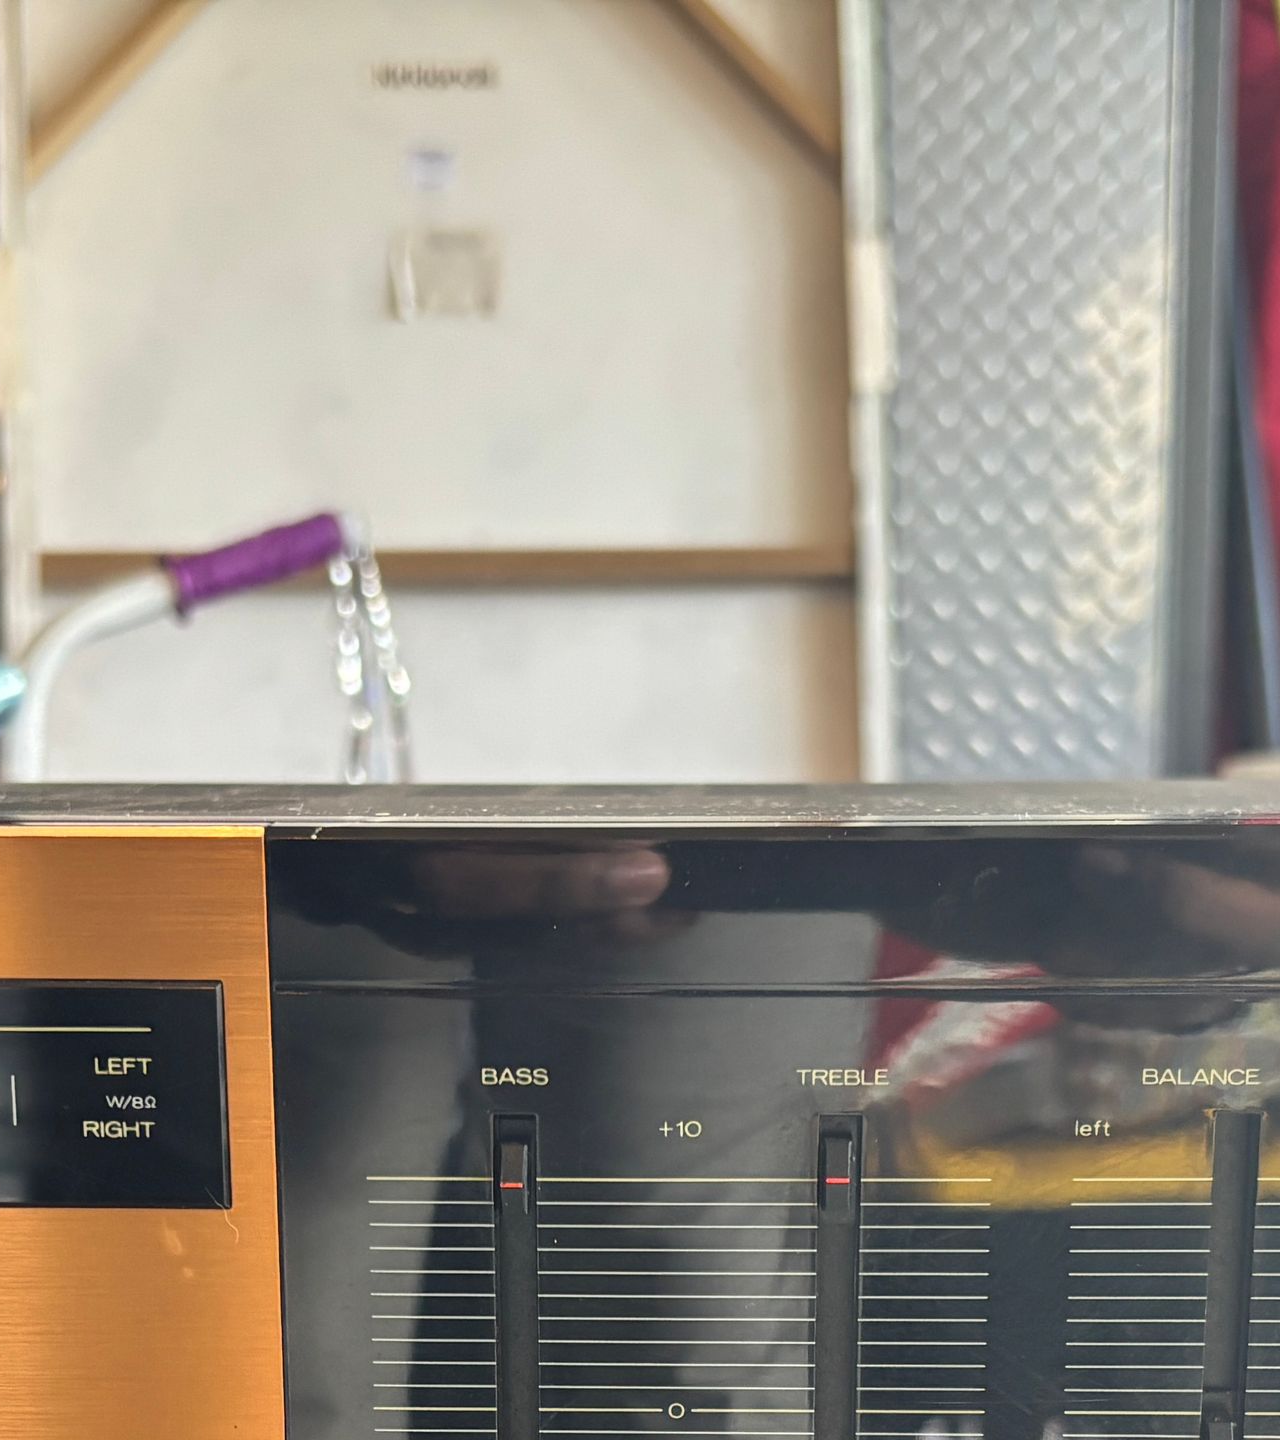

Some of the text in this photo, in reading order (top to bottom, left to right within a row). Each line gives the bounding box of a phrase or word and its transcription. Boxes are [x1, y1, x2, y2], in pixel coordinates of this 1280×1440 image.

[94, 1057, 153, 1075] LEFT
[481, 1067, 549, 1086] BASS
[796, 1068, 890, 1086] TREBLE
[1141, 1068, 1262, 1086] BALANCE
[82, 1120, 156, 1139] RIGHT
[658, 1120, 702, 1138] +10
[1075, 1119, 1110, 1137] left
